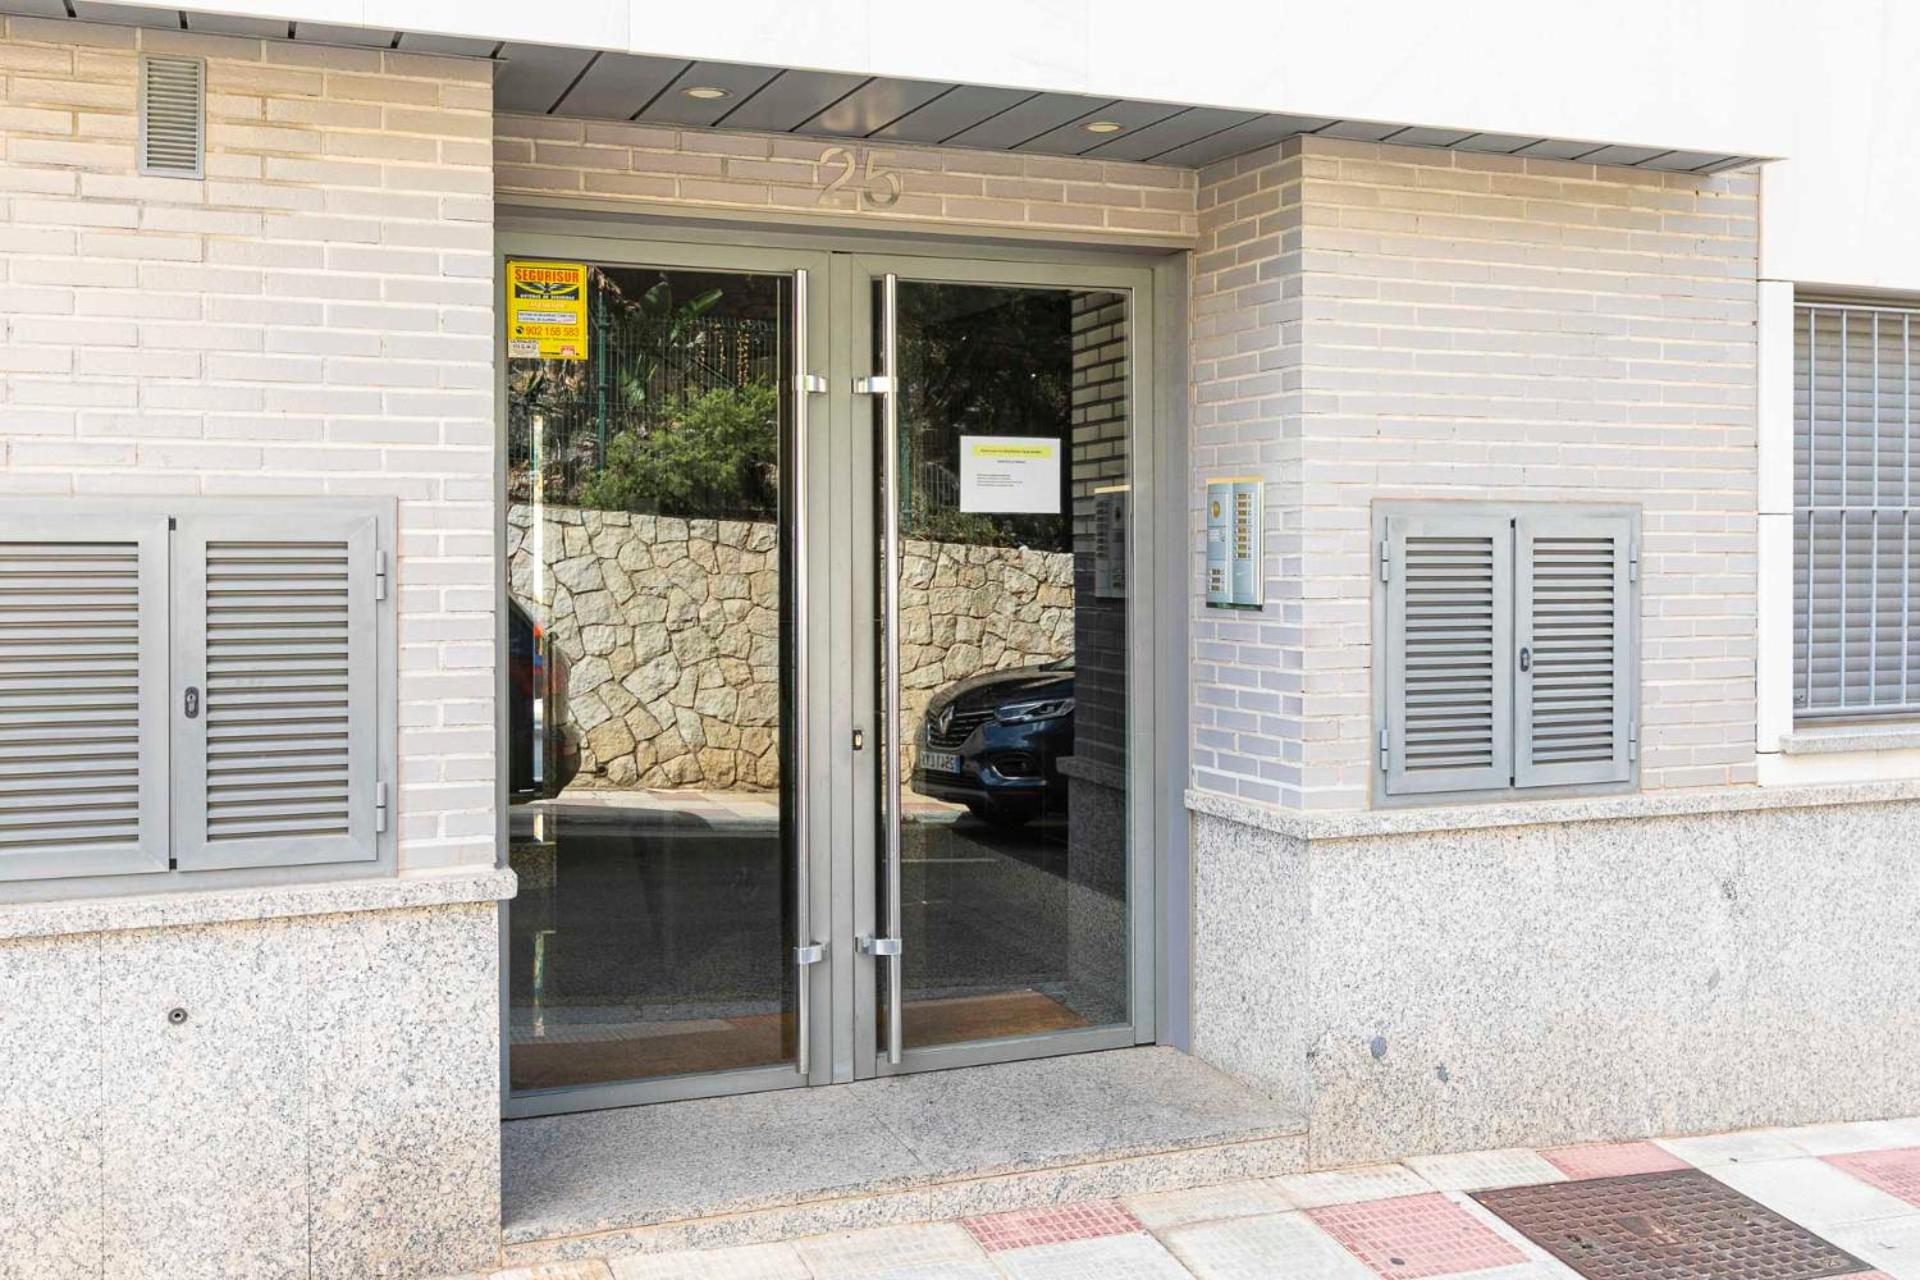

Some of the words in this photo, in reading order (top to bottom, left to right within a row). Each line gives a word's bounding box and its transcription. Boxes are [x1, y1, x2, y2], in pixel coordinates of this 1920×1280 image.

[818, 146, 901, 207] 25
[514, 268, 580, 283] SEGURISUR
[525, 326, 542, 336] 902
